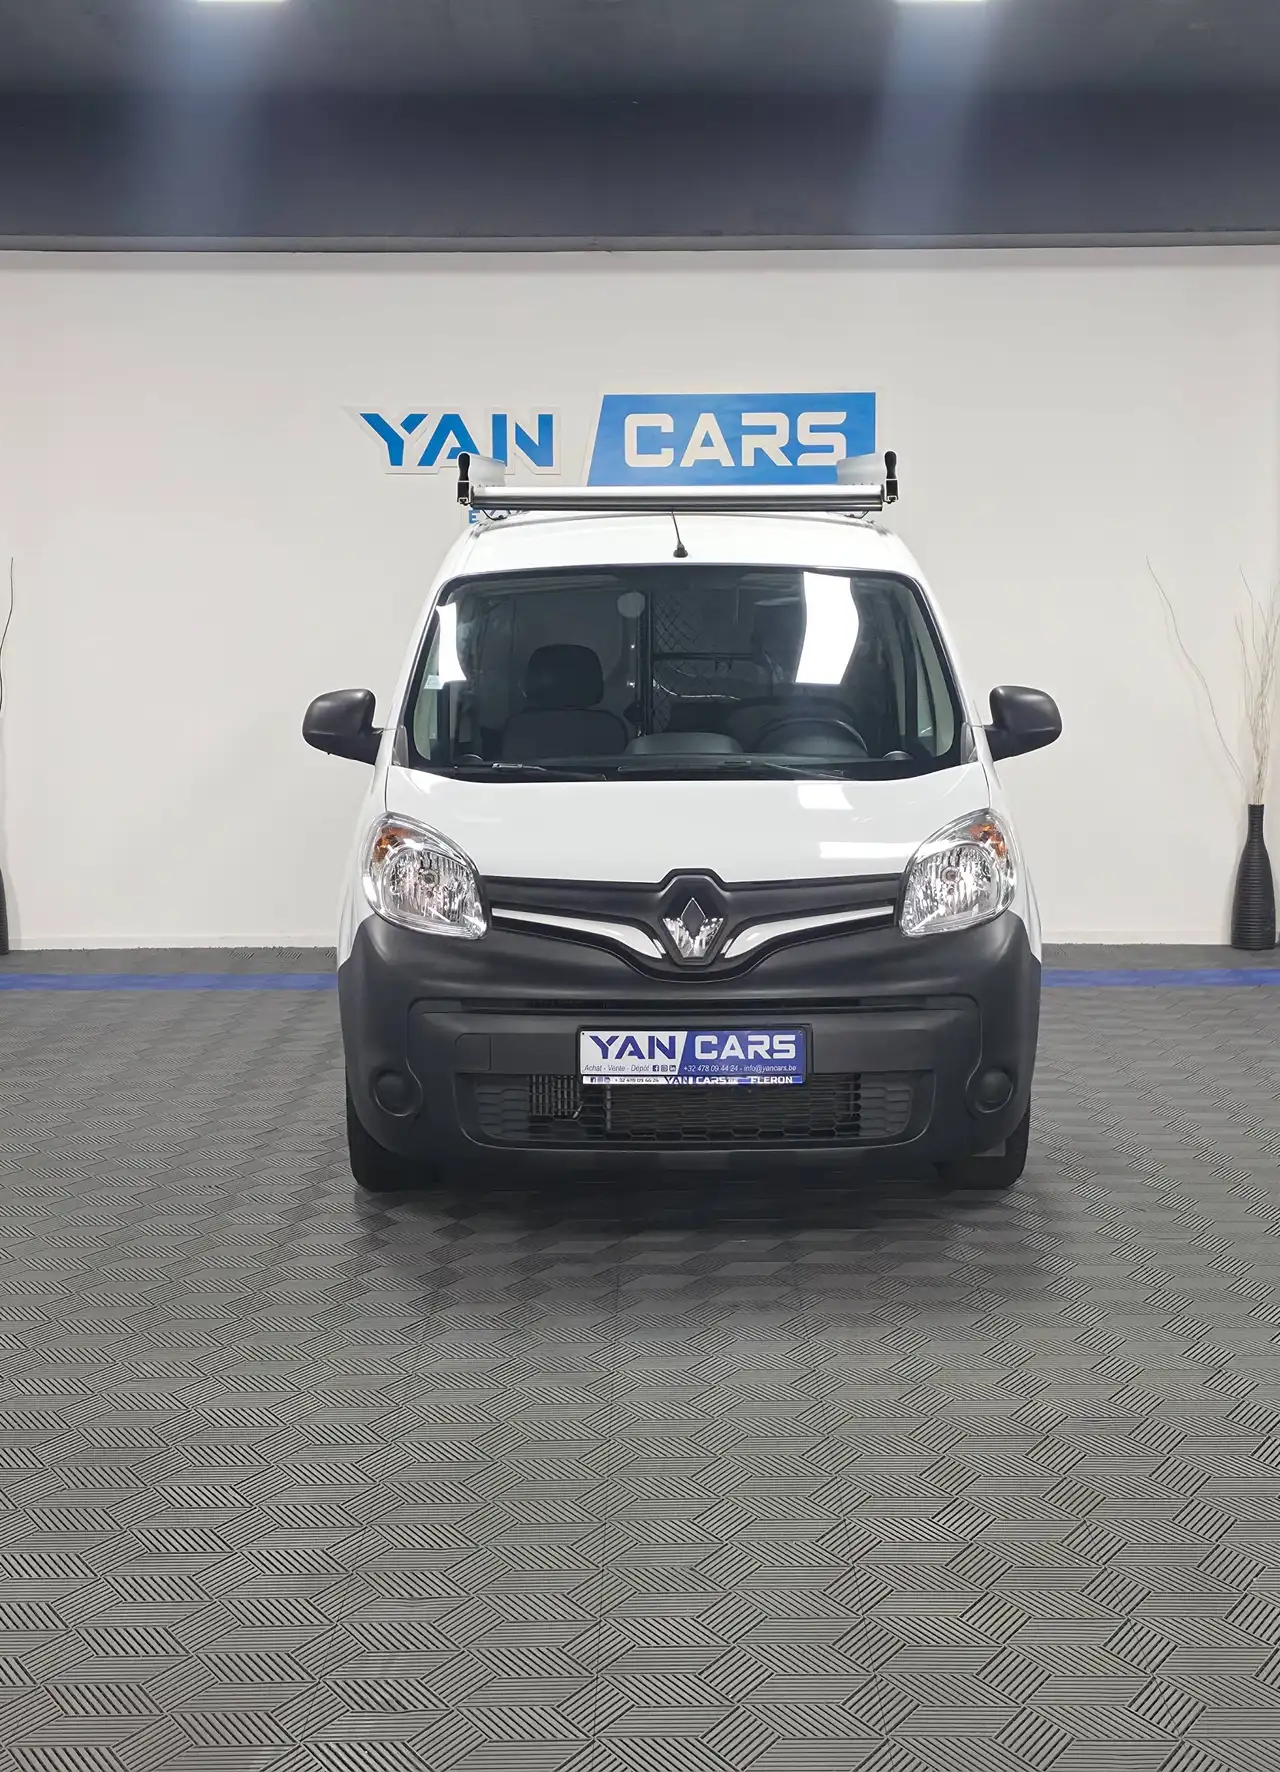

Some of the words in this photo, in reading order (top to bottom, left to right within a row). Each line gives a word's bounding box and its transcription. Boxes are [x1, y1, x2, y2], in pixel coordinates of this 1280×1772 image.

[360, 412, 554, 467] YAN
[624, 411, 847, 468] CARS
[589, 1035, 677, 1060] YAN
[694, 1034, 797, 1060] CARS
[608, 1064, 626, 1072] Vente
[683, 1064, 696, 1073] +32
[697, 1064, 710, 1073] 478
[710, 1064, 720, 1073] 09
[720, 1064, 729, 1073] 44
[730, 1064, 739, 1073] 24
[750, 1076, 793, 1084] FLERON
